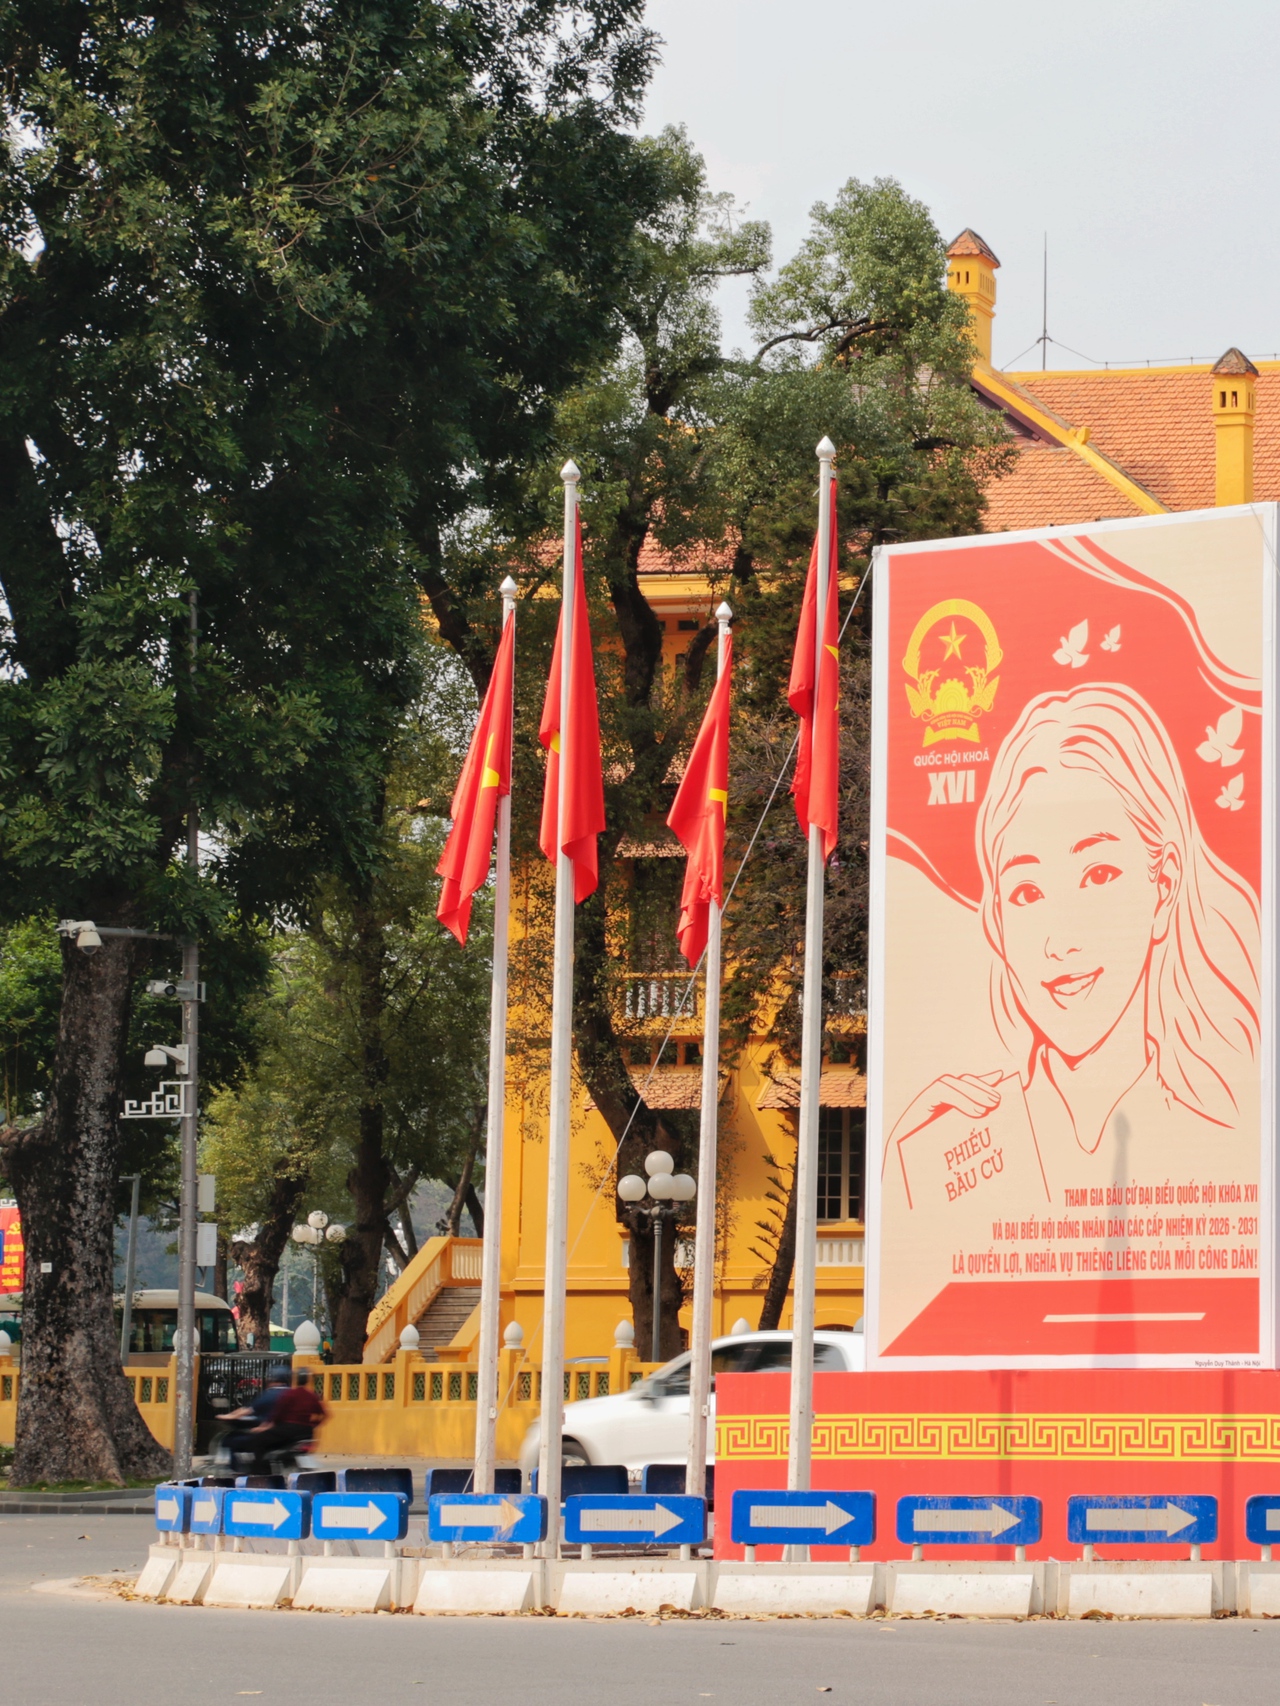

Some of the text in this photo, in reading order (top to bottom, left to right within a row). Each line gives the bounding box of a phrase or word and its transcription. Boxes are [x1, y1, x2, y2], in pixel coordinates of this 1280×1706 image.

[914, 747, 990, 767] QUỐC HỘI KHOÁ
[927, 769, 976, 806] XVI
[944, 1127, 991, 1171] PHIẾU
[945, 1147, 1004, 1202] BẦU CỬ
[1064, 1178, 1258, 1209] THAM GIA BẦU CỬ ĐẠI BIỂU QUỐC HỘI KHÓA XVI
[992, 1218, 1003, 1240] VÀ
[1005, 1222, 1018, 1244] ĐẠI
[1021, 1214, 1039, 1240] BIỂU
[1041, 1217, 1055, 1243] HỘI
[1057, 1214, 1080, 1239] ĐỒNG
[1082, 1216, 1105, 1238] NHÂN
[1108, 1216, 1125, 1237] DÂN
[1127, 1215, 1144, 1237] CÁC
[1146, 1212, 1163, 1237] CẤP
[1166, 1214, 1193, 1240] NHIỆM
[1196, 1213, 1207, 1236] KỲ
[1209, 1217, 1230, 1236] 2026
[1238, 1217, 1258, 1236] 2031
[952, 1241, 1258, 1278] LÀ QUYỀN LỢI, NGHĨA VỤ THIÊNG LIÊNG CỦA MỖI CÔNG DÂN!
